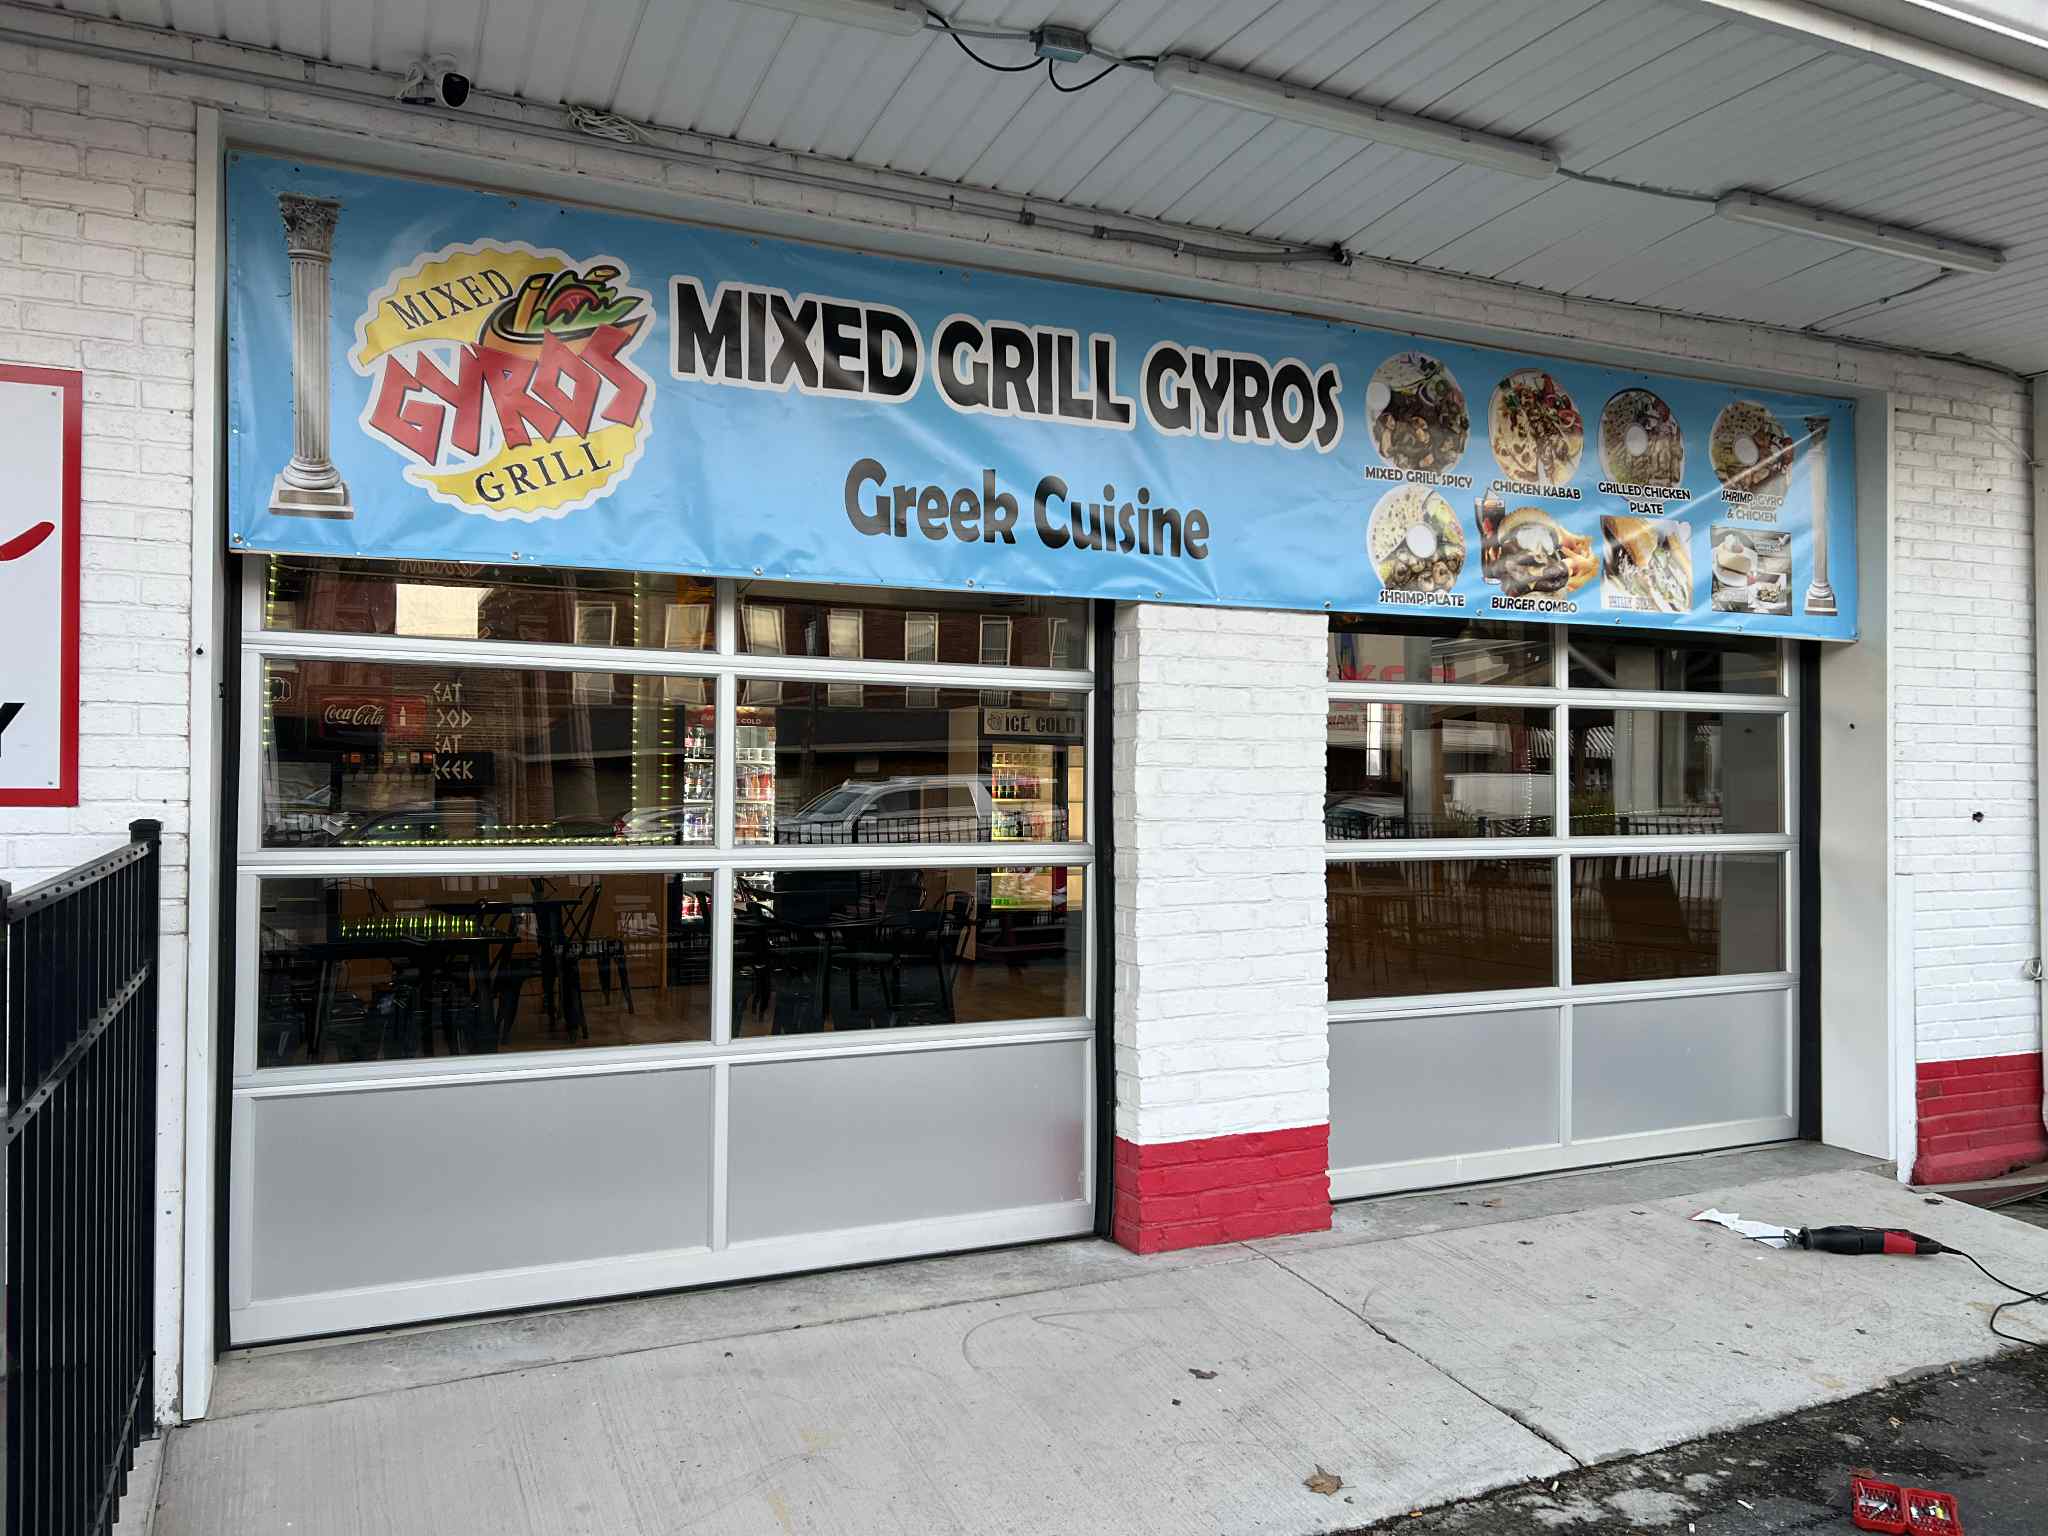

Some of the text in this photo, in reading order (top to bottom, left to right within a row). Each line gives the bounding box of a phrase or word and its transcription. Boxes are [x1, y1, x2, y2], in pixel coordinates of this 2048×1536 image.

[386, 268, 514, 331] MIXED
[676, 282, 1340, 450] MIXED GRILL GYROS
[368, 314, 648, 466] GYROS
[474, 441, 612, 503] GRILL
[1364, 466, 1473, 489] MIXED GRILL SPICY
[1492, 480, 1582, 500] CHICKEN KABAB
[1598, 482, 1691, 501] GRILLED CHICKEN
[844, 457, 1210, 560] Greek Cuisine
[1629, 501, 1664, 515] PLATE
[1736, 508, 1778, 523] CHICKEN
[1379, 589, 1465, 608] SHRIMP PLATE
[1491, 596, 1578, 614] BURGER COMBO
[323, 703, 385, 726] Coca-Cola
[1004, 713, 1030, 732] ICE
[1035, 715, 1077, 734] COLD
